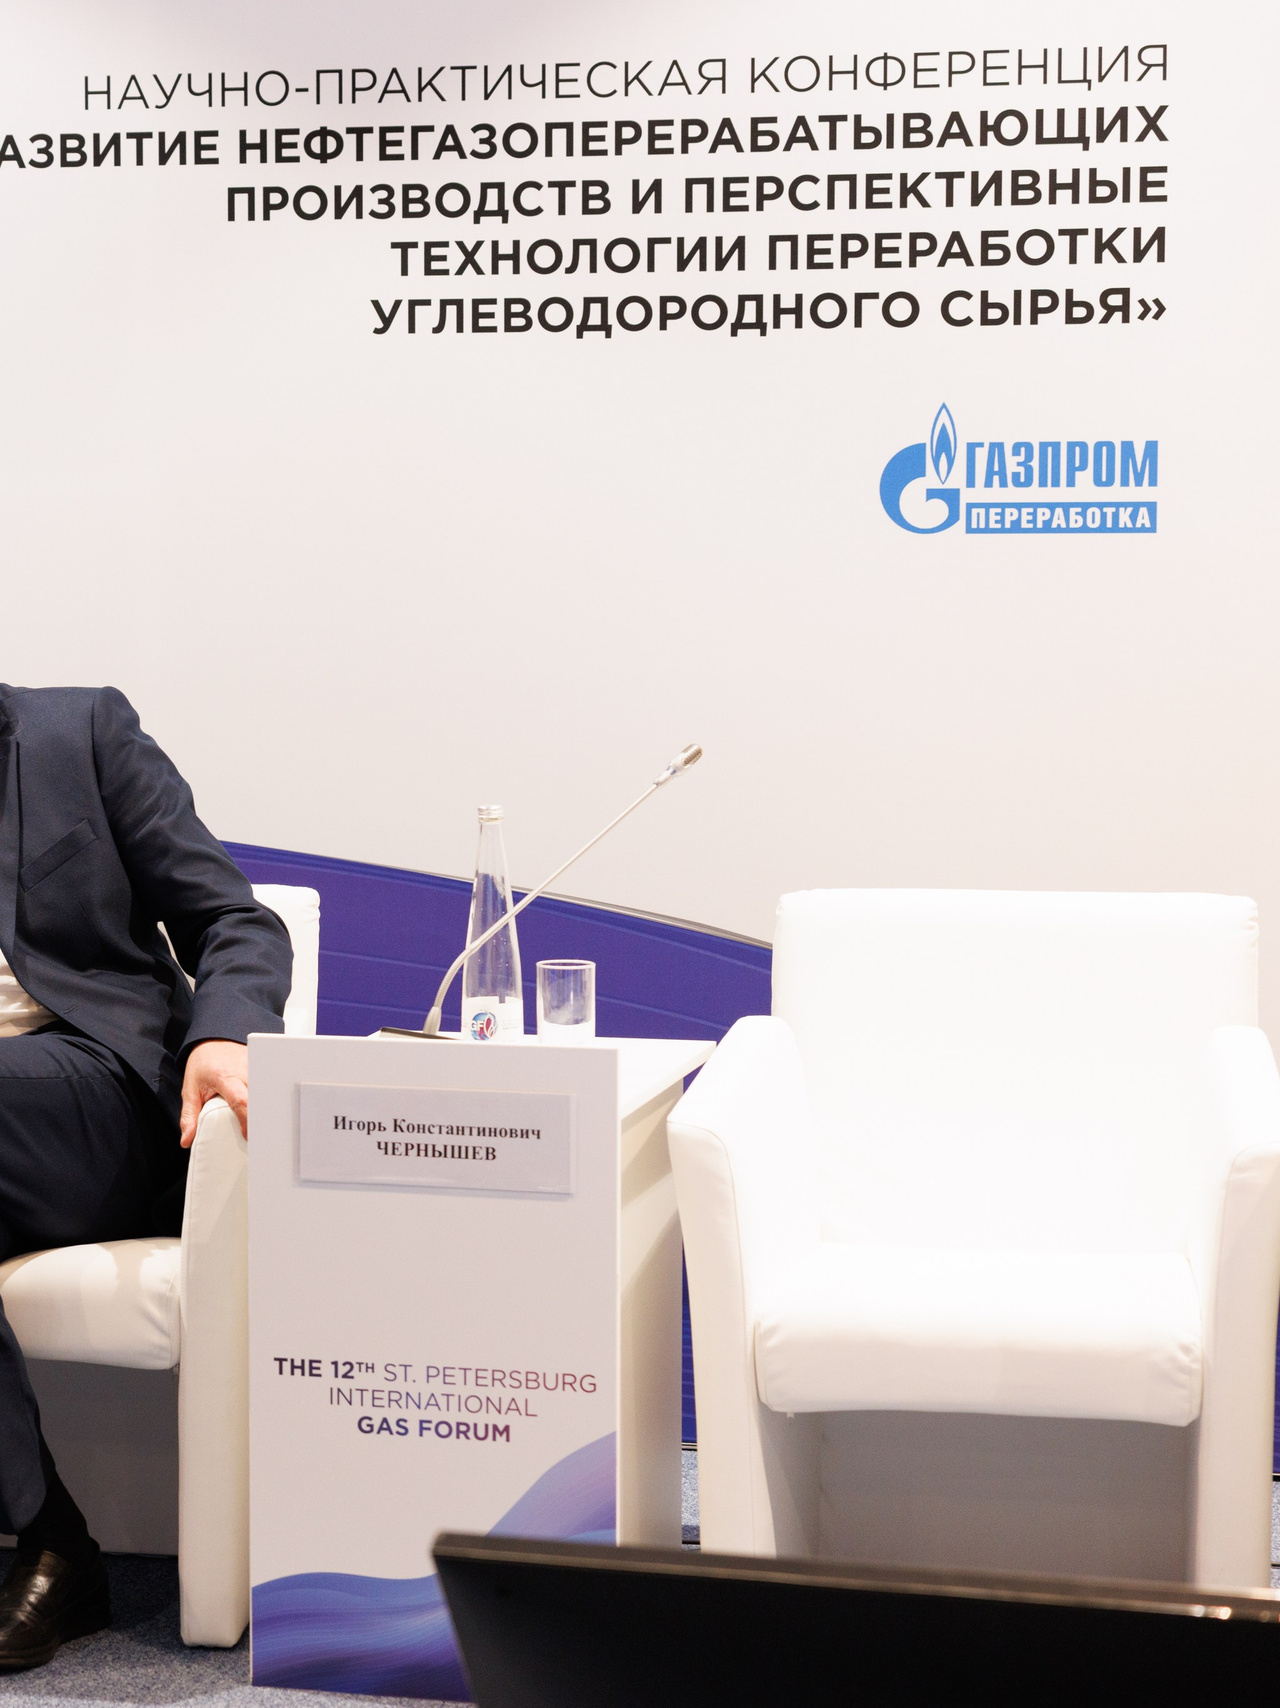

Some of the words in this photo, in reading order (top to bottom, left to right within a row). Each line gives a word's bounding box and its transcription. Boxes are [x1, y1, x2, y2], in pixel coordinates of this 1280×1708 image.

[84, 58, 727, 111] НАУЧНО-ПРАКТИЧЕСКАЯ
[750, 43, 1168, 94] КОНФЕРЕНЦИЯ
[238, 104, 1169, 165] НЕФТЕГАЗОПЕРЕРАБАТЫВАЮЩИХ
[227, 179, 612, 225] ПРОИЗВОДСТВ
[631, 178, 663, 215] И
[684, 165, 1168, 214] ПЕРСПЕКТИВНЫЕ
[390, 235, 746, 277] ТЕХНОЛОГИИ
[768, 226, 1166, 271] ПЕРЕРАБОТКИ
[370, 290, 921, 340] УГЛЕВОДОРОДНОГО
[940, 287, 1167, 328] СЫРЬЯ»
[965, 440, 1159, 488] ГАЗПРОМ
[970, 506, 1152, 529] ПЕРЕРАБОТКА
[333, 1115, 387, 1136] Игорь
[392, 1118, 541, 1140] Константинович
[376, 1141, 497, 1161] ЧЕРНЫШЕВ
[273, 1357, 323, 1378] THE
[330, 1360, 375, 1380] 12TH
[383, 1363, 417, 1385] ST.
[426, 1365, 597, 1394] PETERSBURG
[329, 1386, 538, 1418] INTERNATIONAL
[357, 1415, 409, 1437] GAS
[418, 1419, 511, 1443] FORUM
